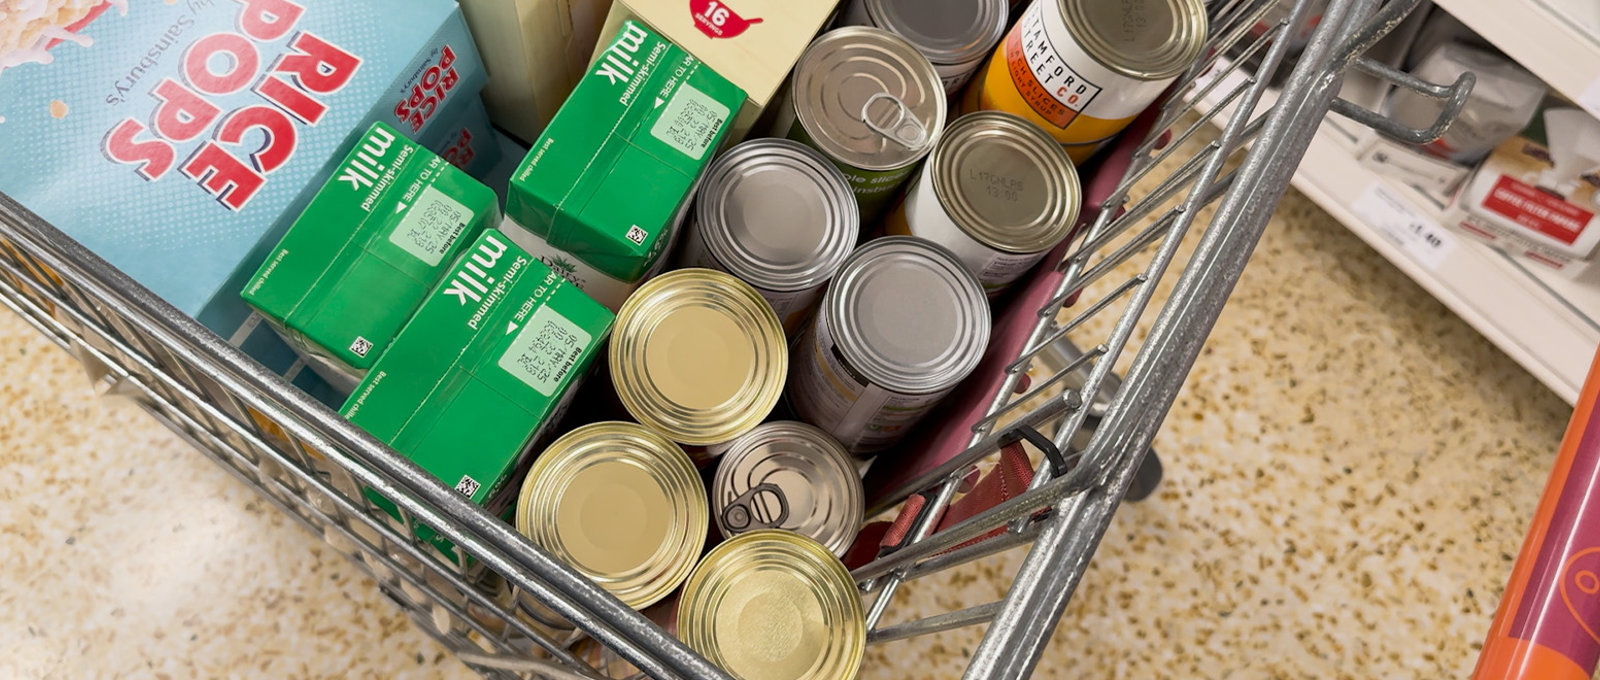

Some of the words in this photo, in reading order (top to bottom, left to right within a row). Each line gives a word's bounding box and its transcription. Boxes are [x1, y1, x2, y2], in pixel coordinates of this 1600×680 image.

[695, 12, 723, 36] SERVINGS
[704, 1, 729, 27] 16
[105, 14, 195, 107] Sainsbury's
[595, 20, 648, 86] milk
[394, 44, 457, 124] POPS
[619, 41, 666, 106] Semi-skimmed
[675, 66, 687, 78] TO
[100, 0, 306, 182] POPS
[660, 76, 678, 98] HERE
[1027, 79, 1065, 115] SLICES
[1056, 85, 1079, 108] CO.
[408, 67, 460, 134] RICE
[1026, 90, 1052, 115] SYRUP
[177, 29, 364, 213] RICE
[712, 118, 723, 132] Best
[701, 131, 715, 148] before
[338, 127, 396, 191] milk
[360, 144, 414, 212] Semi-skimmed
[420, 168, 433, 180] TO
[402, 179, 423, 203] HERE
[453, 222, 466, 235] Best
[439, 234, 457, 255] before
[443, 235, 508, 307] milk
[467, 256, 527, 330] Semi-skimmed
[534, 285, 548, 297] TO
[514, 297, 537, 322] HERE
[569, 346, 582, 362] Best
[553, 361, 573, 383] before
